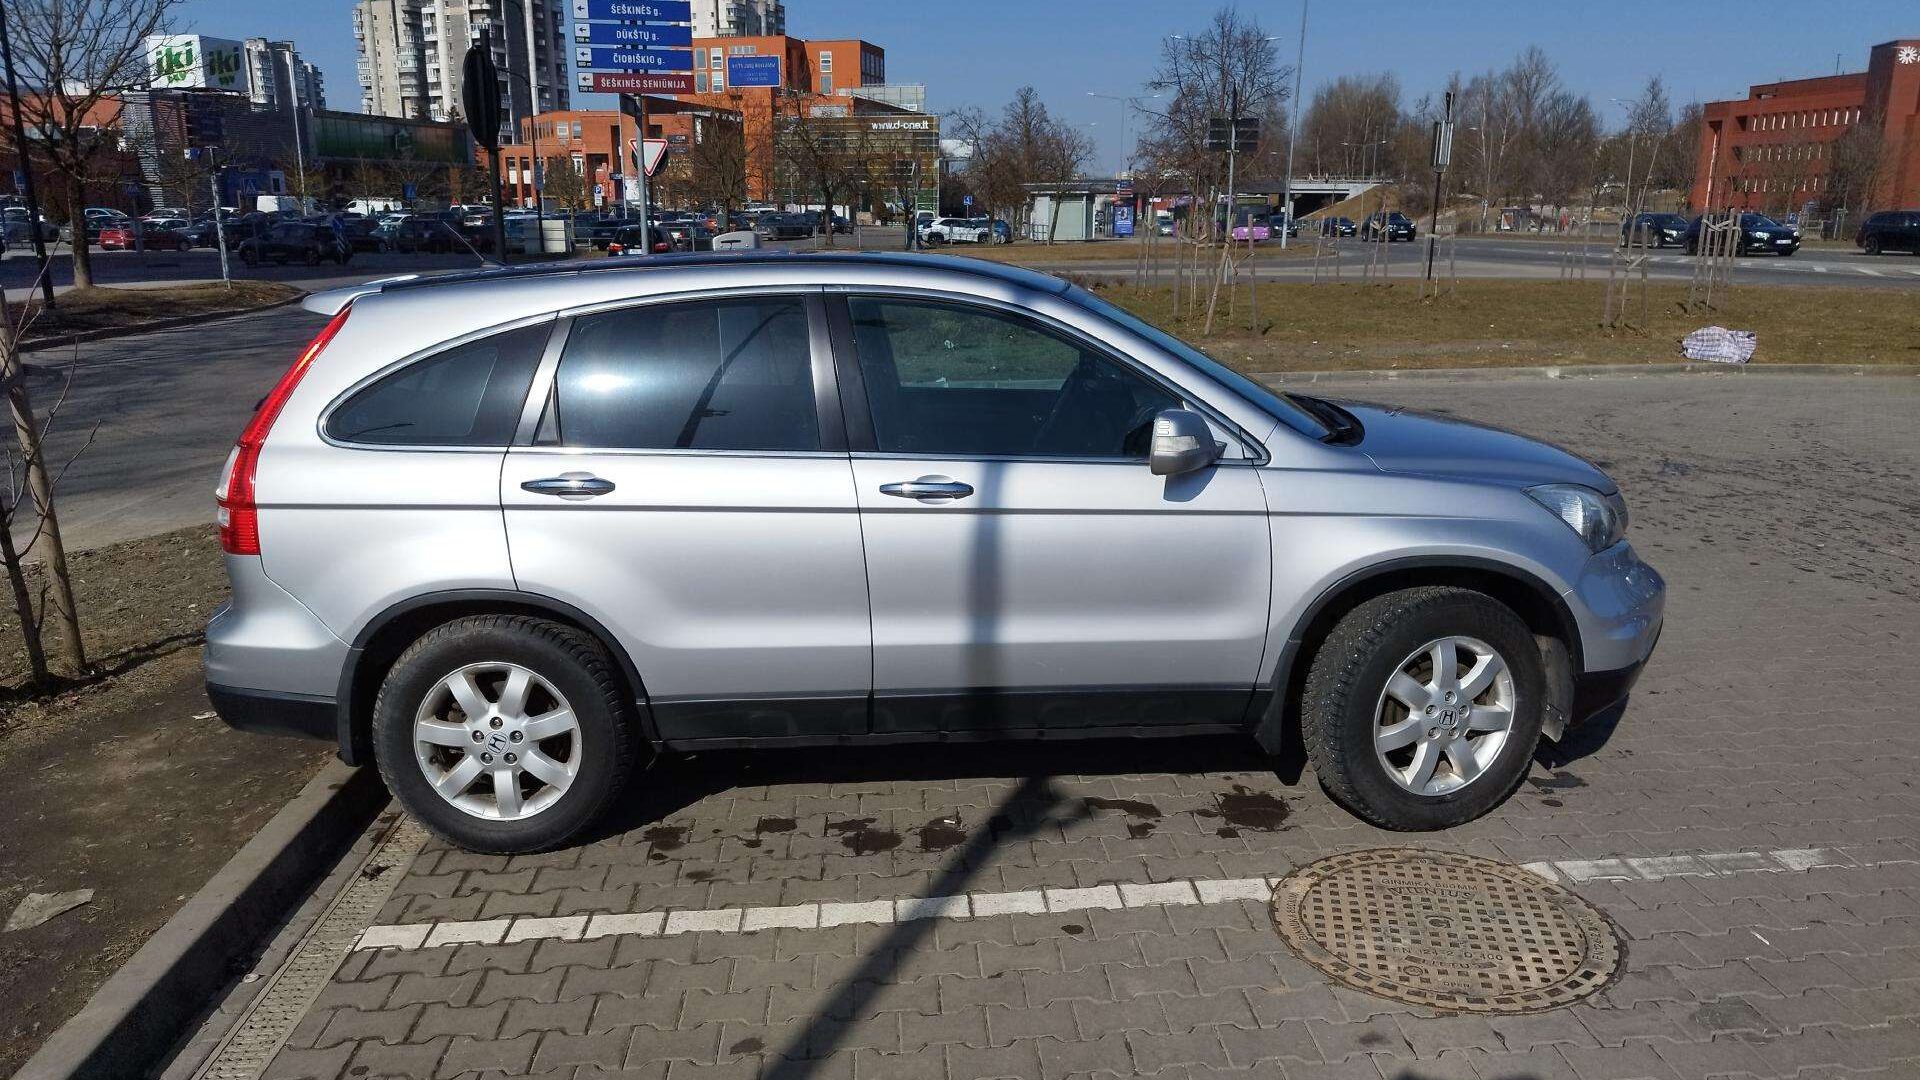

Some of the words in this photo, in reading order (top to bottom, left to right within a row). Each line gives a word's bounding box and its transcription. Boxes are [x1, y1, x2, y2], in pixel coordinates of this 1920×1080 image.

[611, 4, 651, 15] ŠEŠKINĖS
[653, 8, 662, 17] g.
[616, 28, 649, 42] DŪKŠTŲ
[155, 40, 194, 75] iki
[613, 53, 655, 64] ČIOBIŠKIO
[657, 57, 666, 66] g.
[601, 77, 641, 88] ŠEŠKINĖS
[643, 78, 686, 89] SENIŪNIJA
[871, 120, 930, 130] www.d-one.lt
